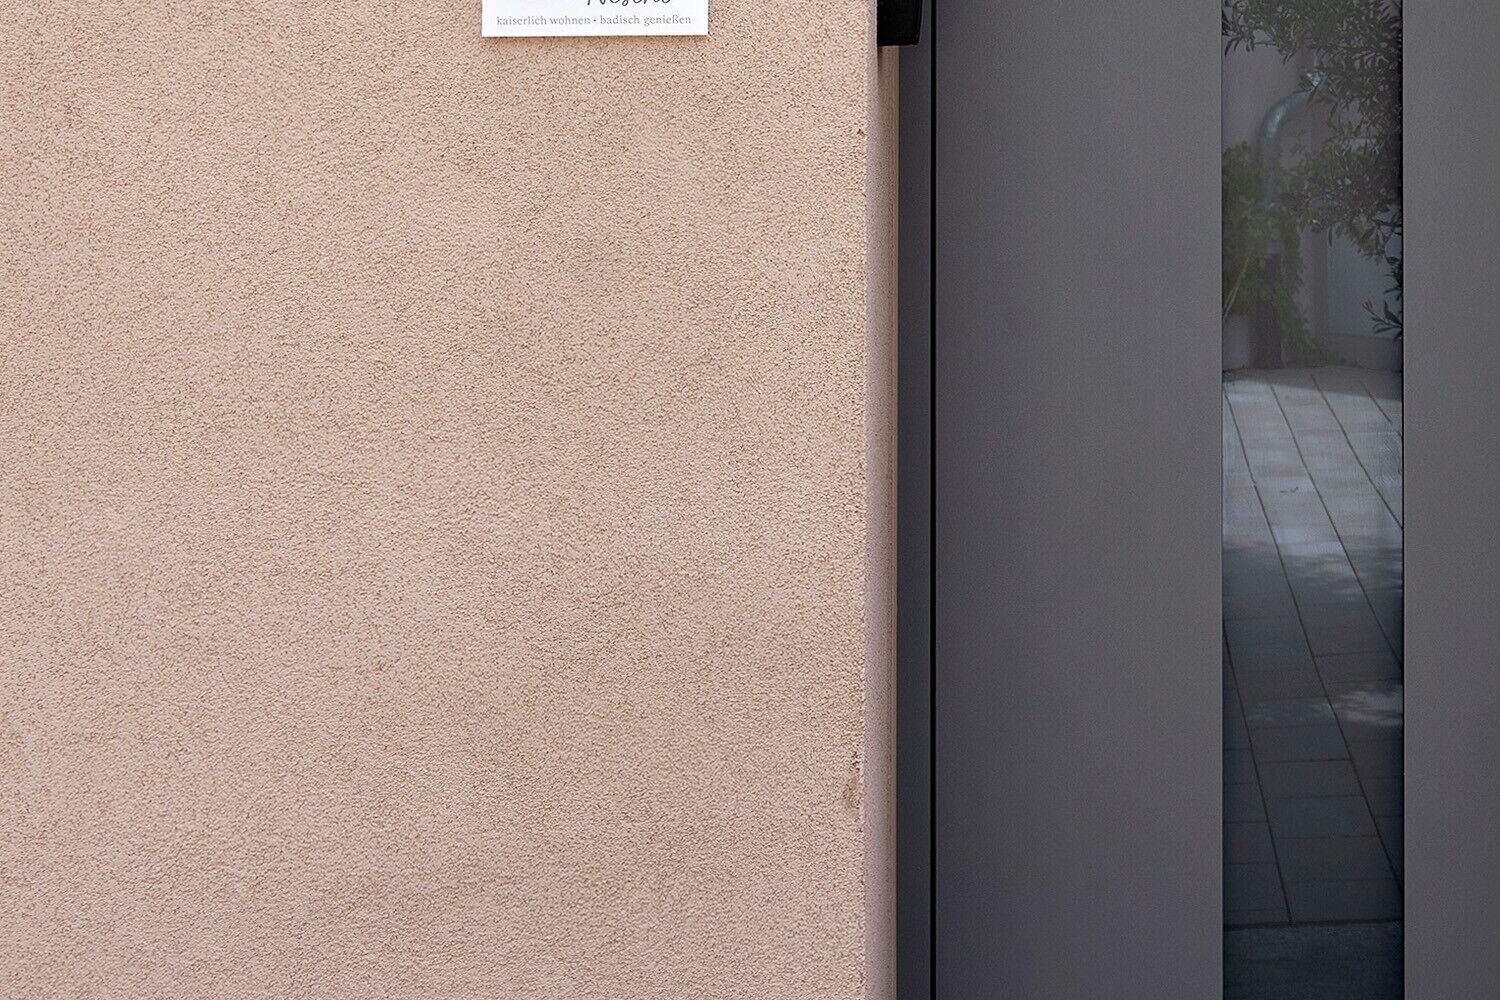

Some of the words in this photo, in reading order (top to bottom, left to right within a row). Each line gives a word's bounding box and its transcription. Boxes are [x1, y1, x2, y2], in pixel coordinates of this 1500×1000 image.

[496, 15, 547, 26] kaiserlich
[549, 15, 591, 26] wohnen
[600, 14, 640, 25] badisch
[643, 14, 692, 27] genießen
